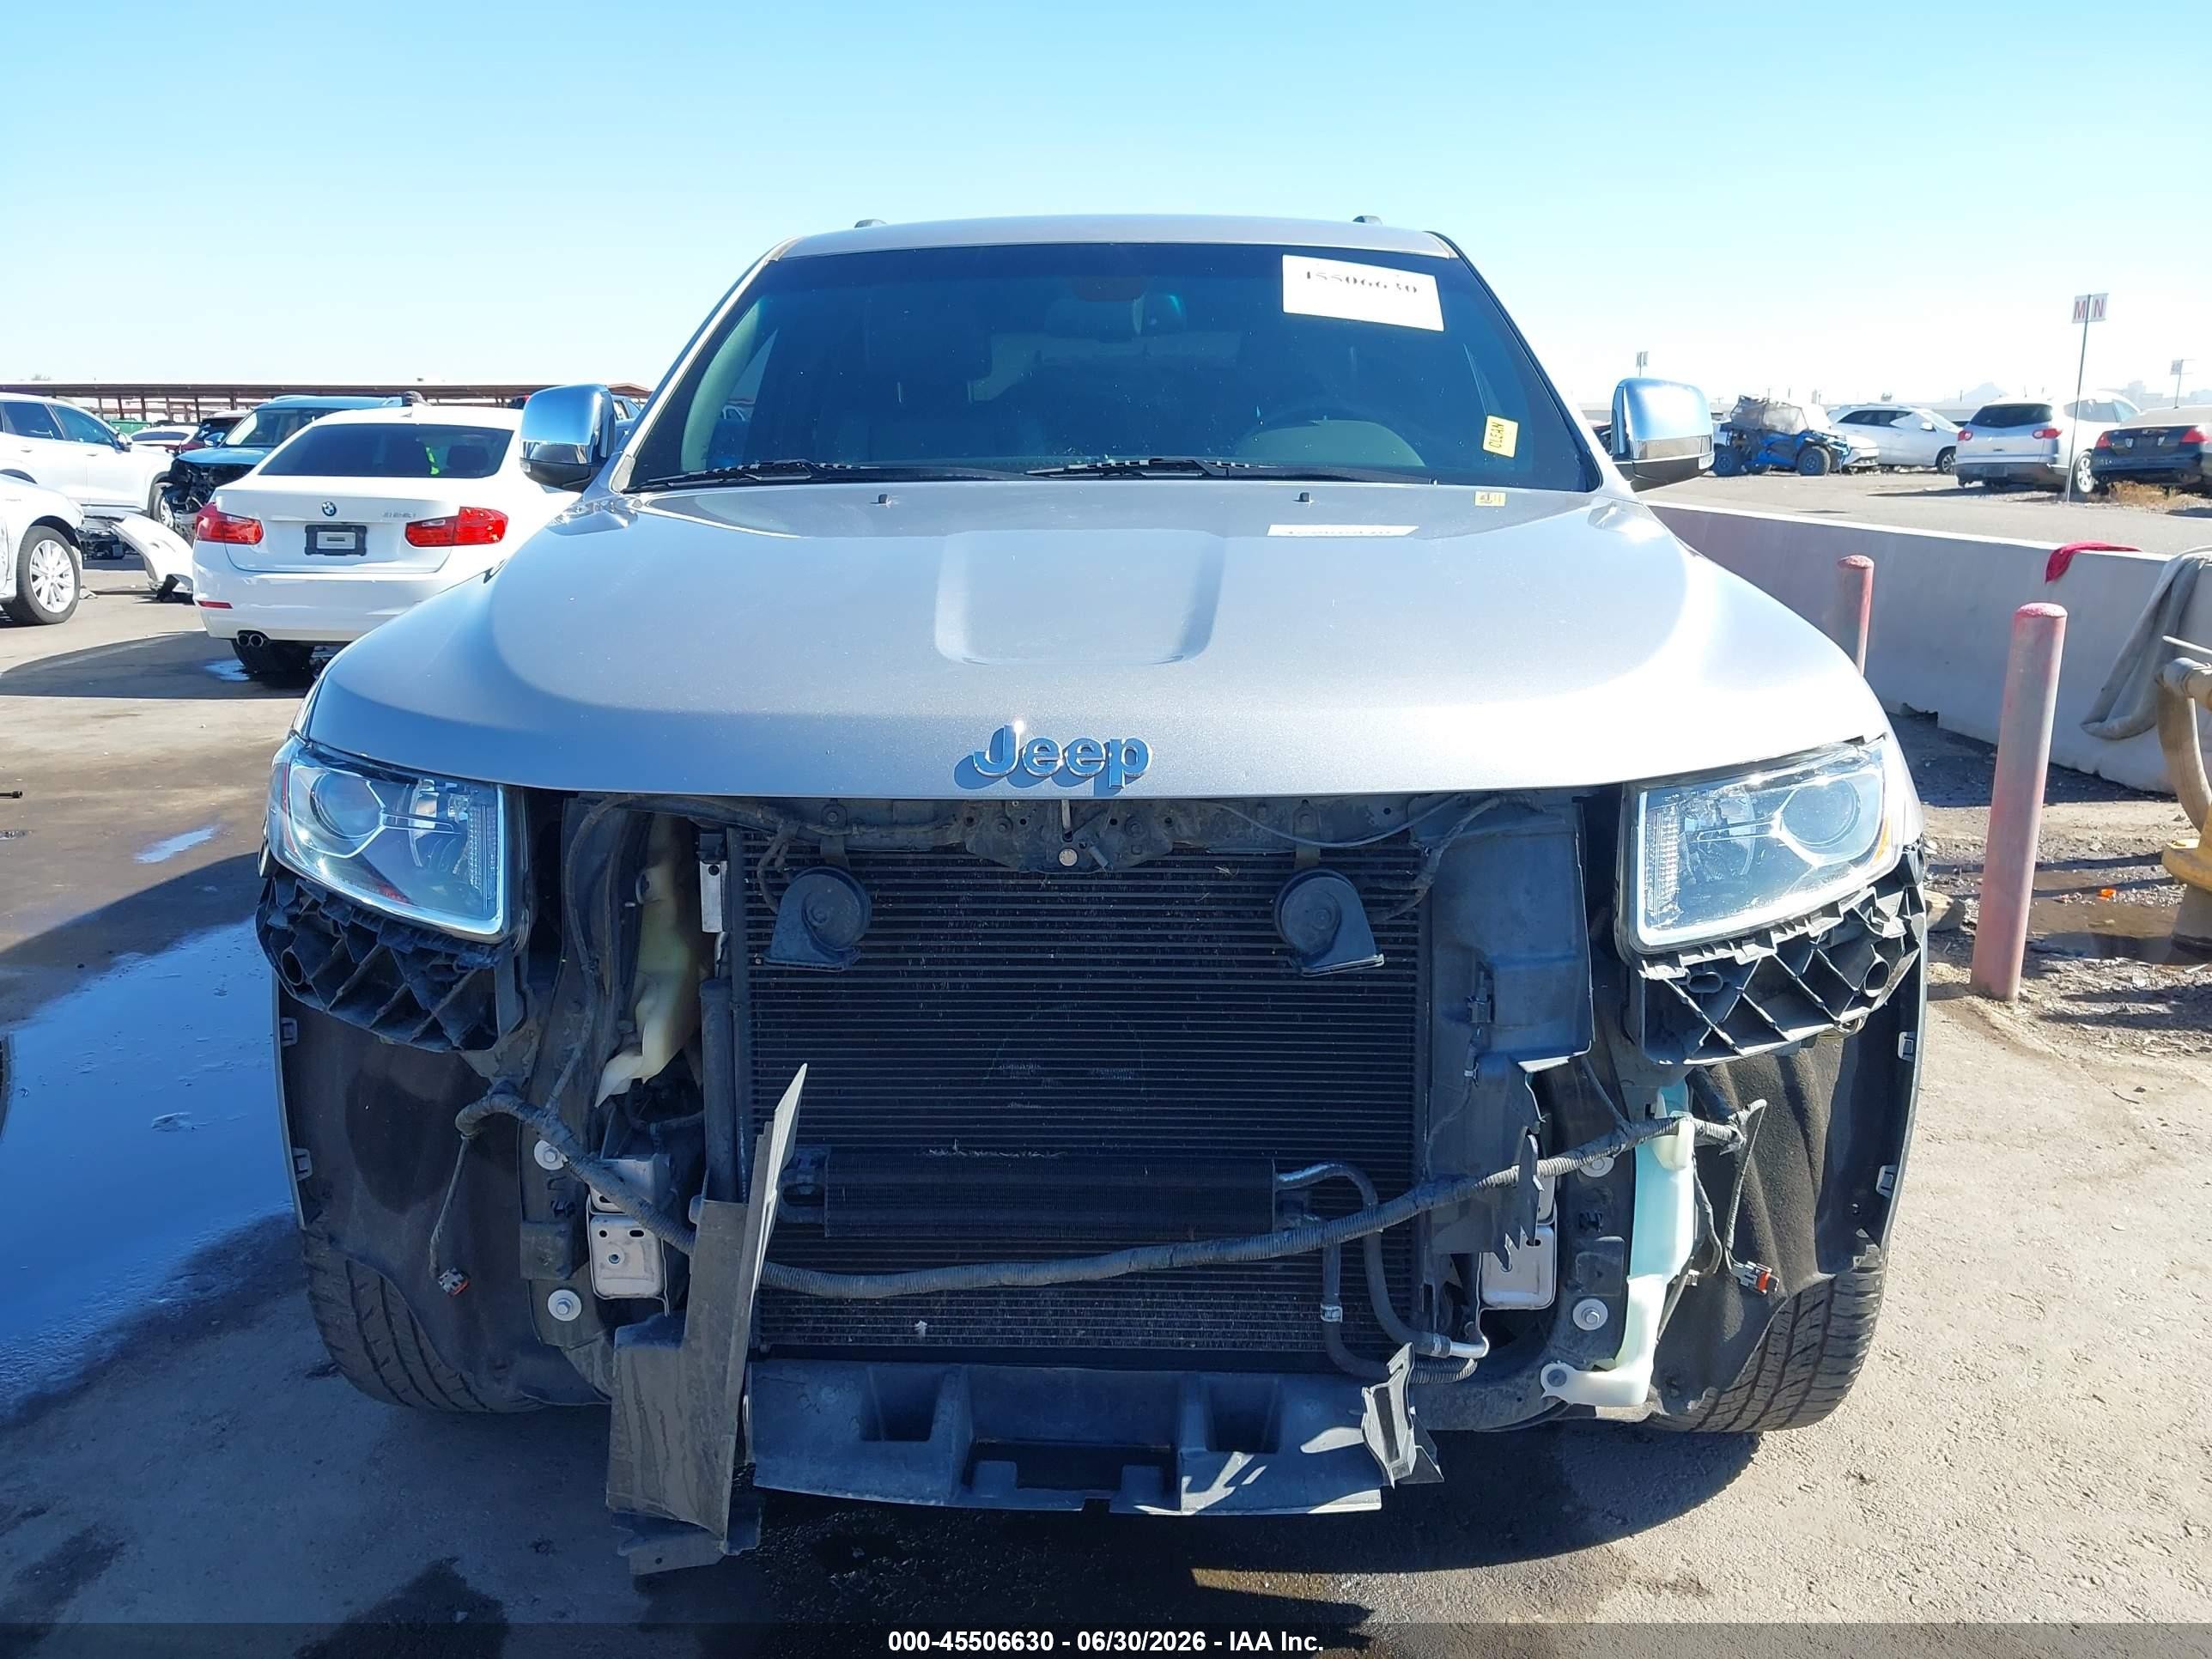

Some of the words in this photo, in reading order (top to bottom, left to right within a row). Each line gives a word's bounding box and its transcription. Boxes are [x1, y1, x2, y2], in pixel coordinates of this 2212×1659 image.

[2074, 301, 2087, 319] M
[2094, 299, 2105, 318] N
[973, 724, 1152, 789] Jeep
